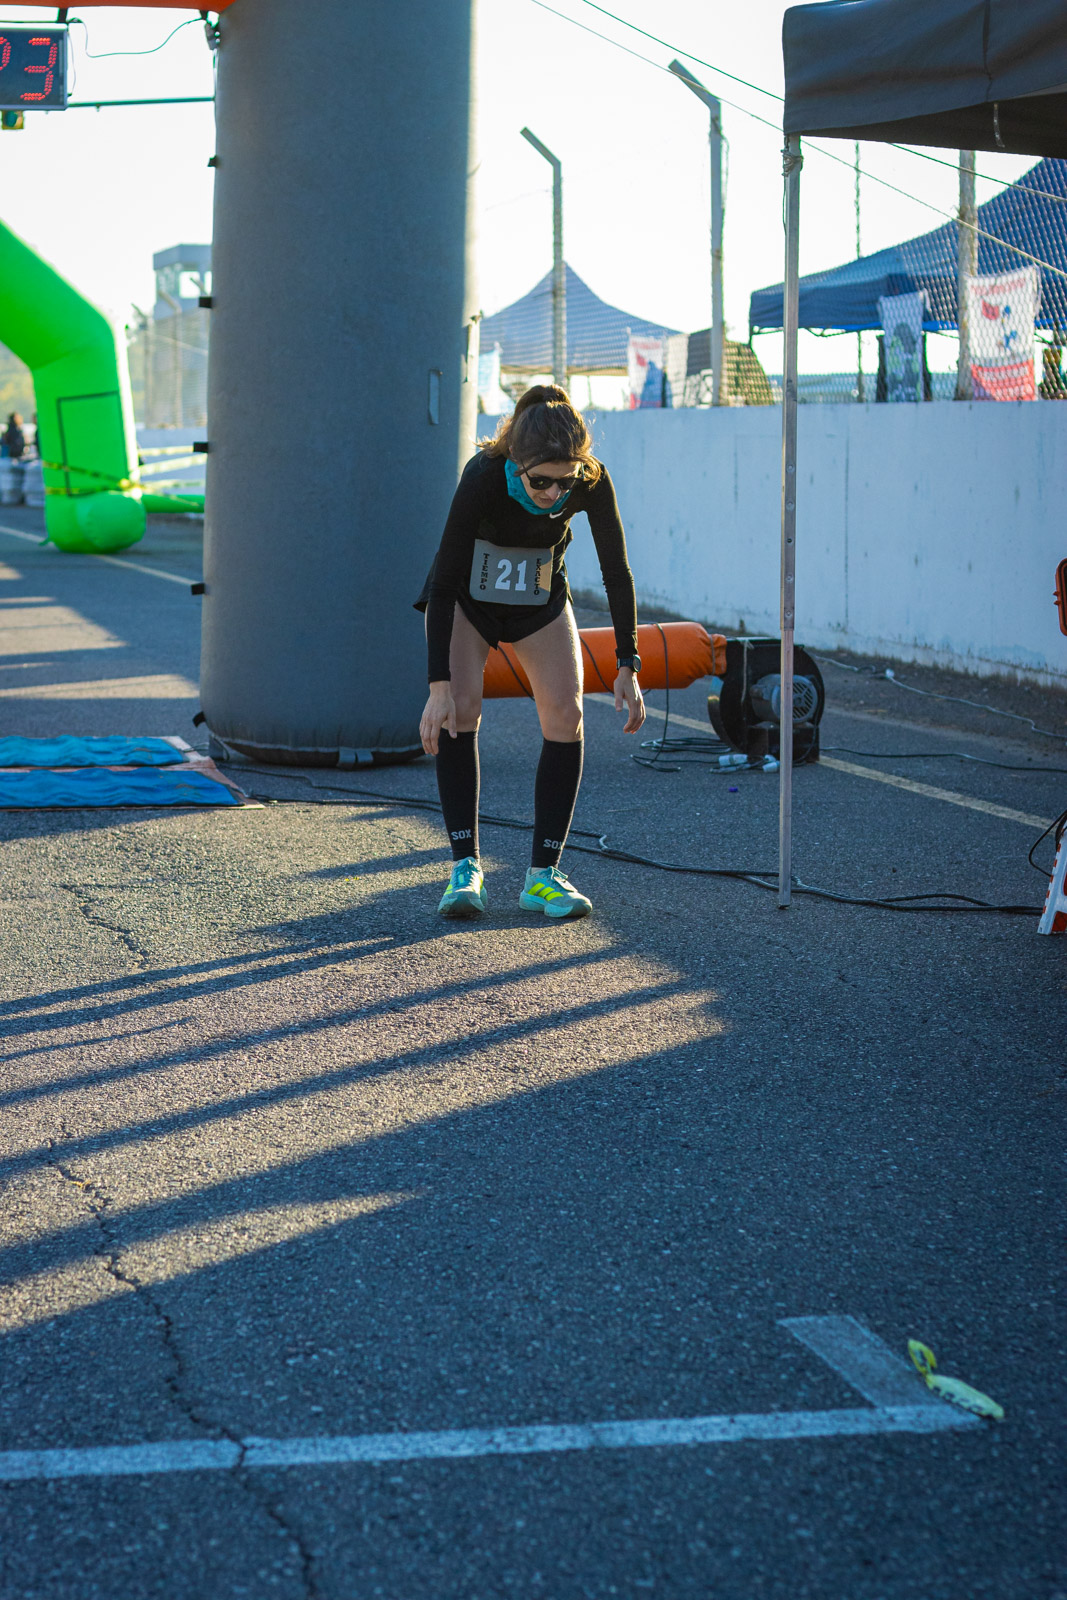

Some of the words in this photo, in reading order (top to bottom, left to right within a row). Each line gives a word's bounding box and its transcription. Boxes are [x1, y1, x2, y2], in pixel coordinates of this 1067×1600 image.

[0, 37, 57, 100] 3
[480, 553, 490, 590] TIEMPO
[495, 559, 527, 591] 21
[533, 558, 542, 595] EXACTO
[451, 829, 472, 840] SOX
